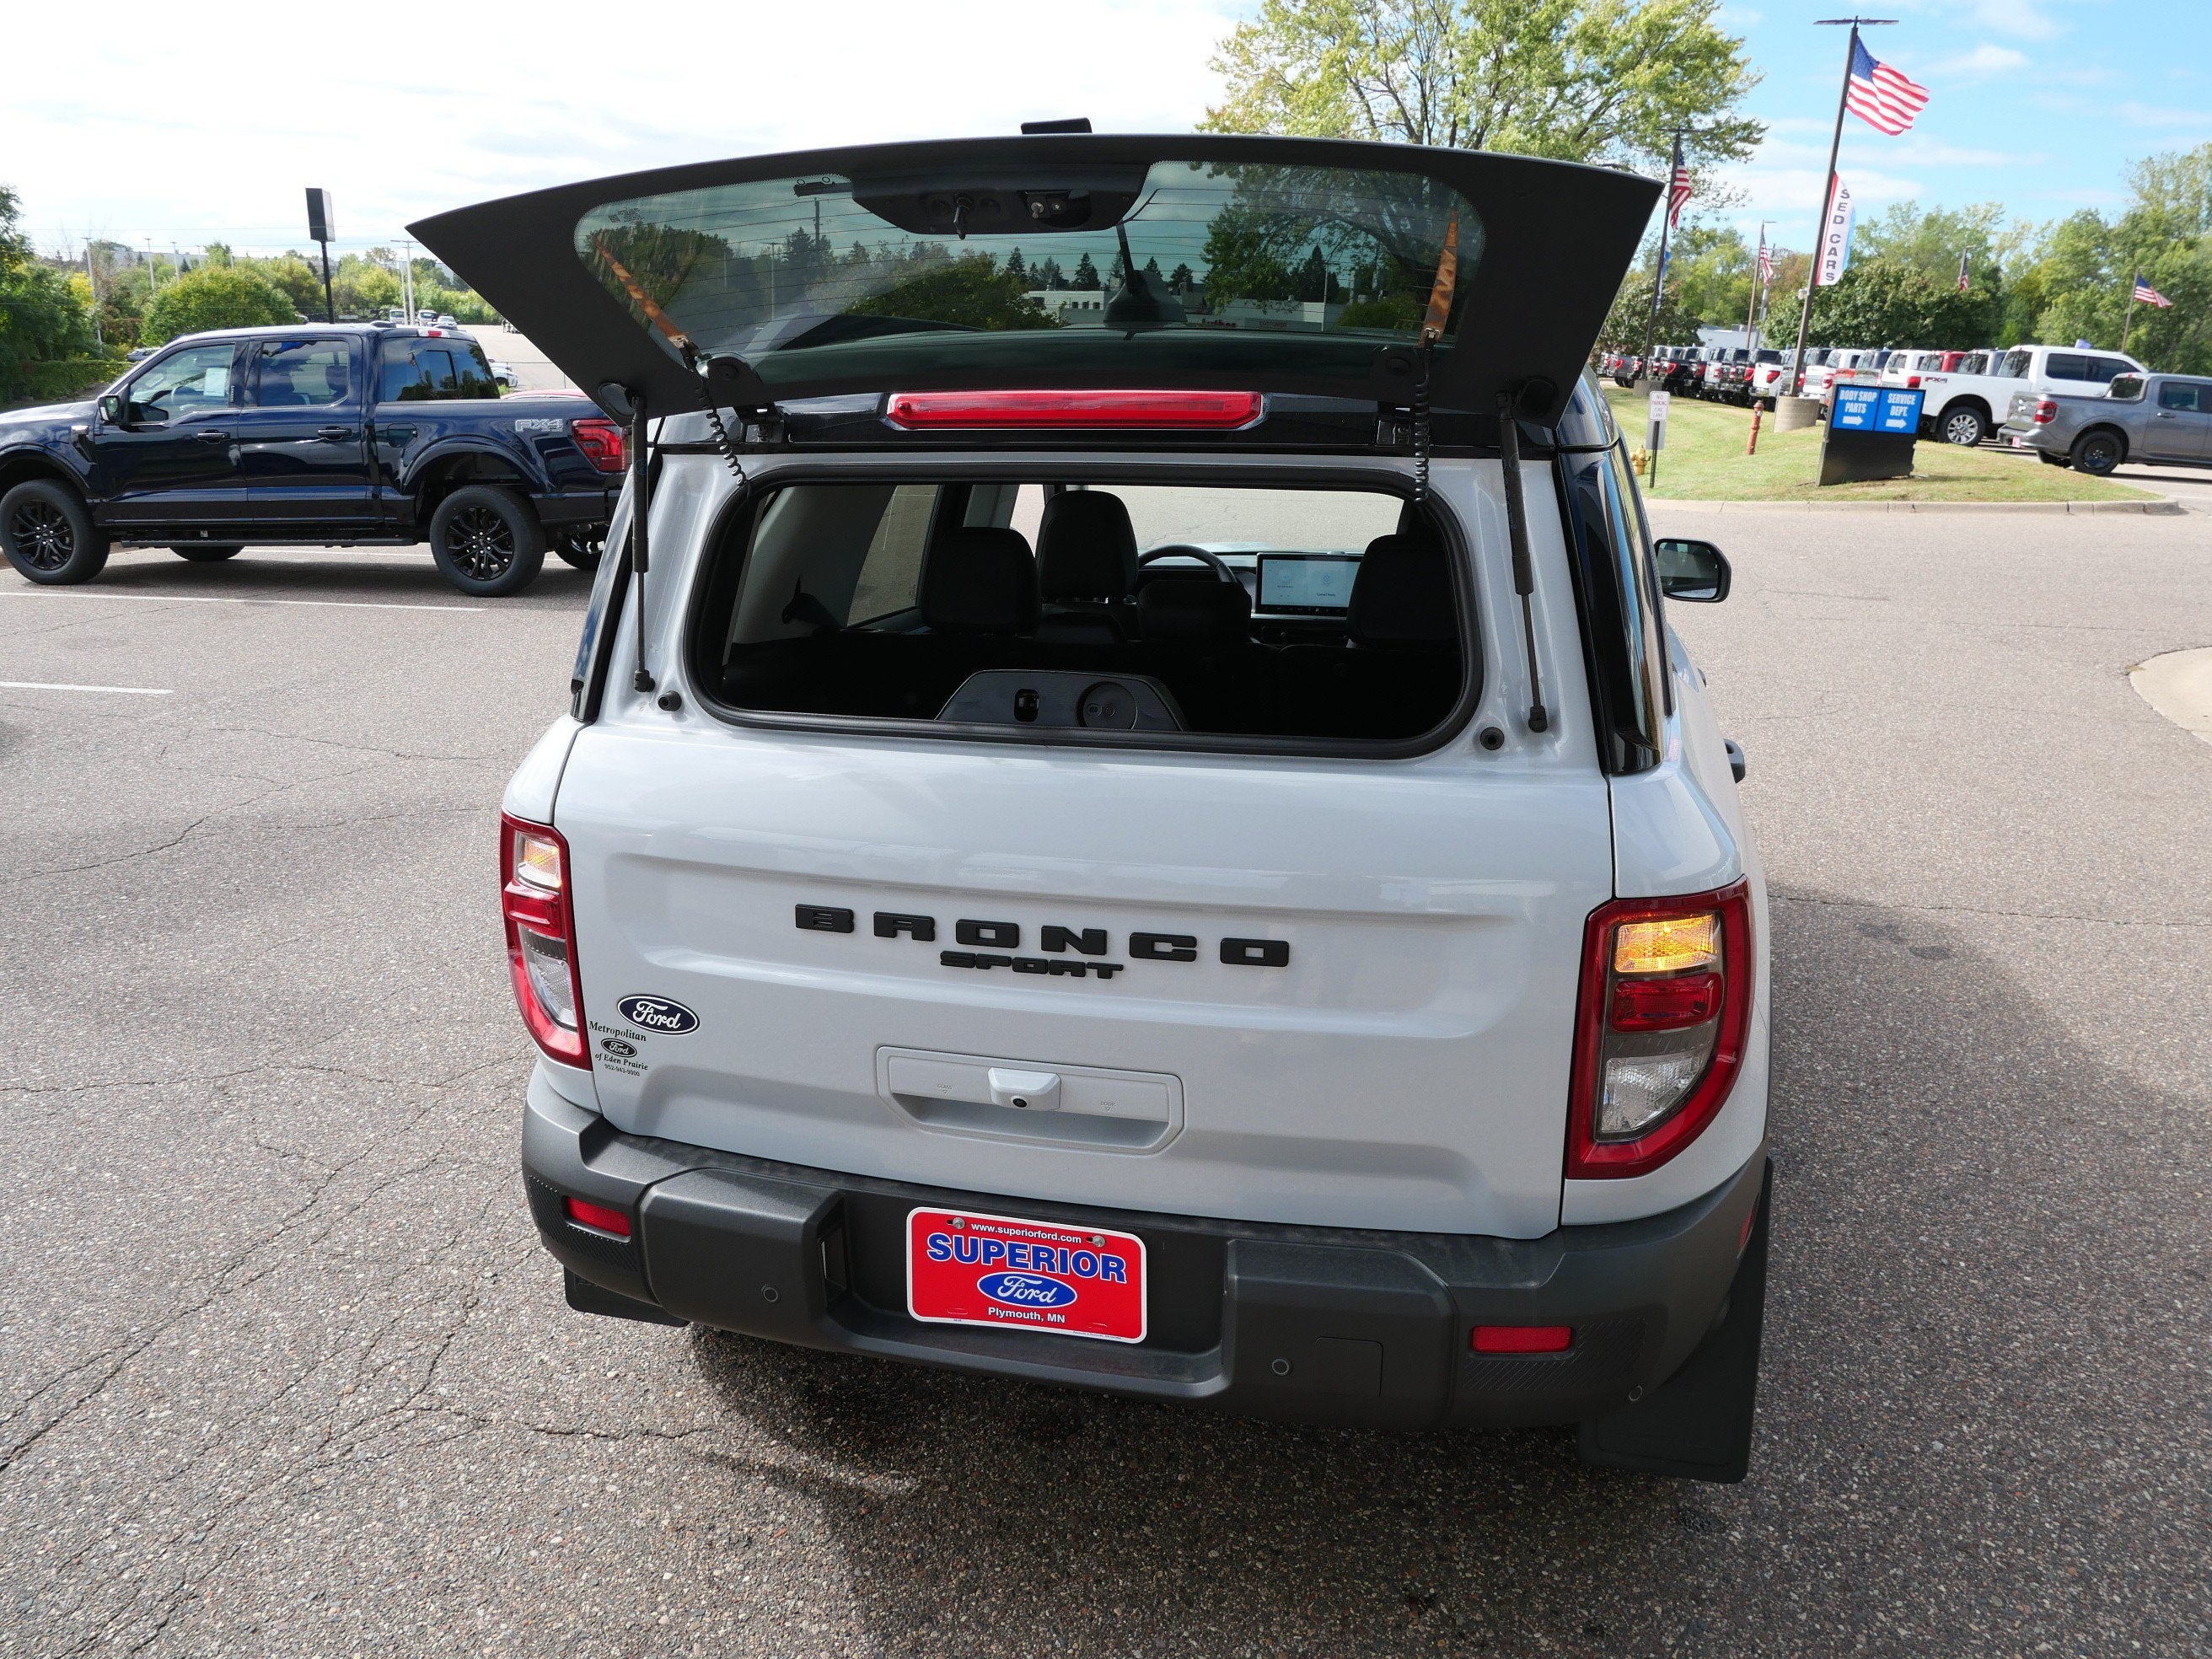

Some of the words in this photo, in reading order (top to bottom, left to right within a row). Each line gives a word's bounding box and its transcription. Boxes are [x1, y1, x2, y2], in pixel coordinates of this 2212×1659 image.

[1833, 189, 1850, 224] SED
[1826, 234, 1841, 282] CARS
[1839, 389, 1858, 400] BODY
[1858, 391, 1877, 402] SHOP
[1887, 393, 1916, 405] SERVICE
[1844, 402, 1867, 414] PARTS
[1889, 405, 1909, 416] DEPT.
[515, 418, 563, 432] FX4
[795, 904, 1290, 967] BRONCO
[940, 951, 1124, 980] SPORT
[632, 1001, 681, 1028] Ford
[589, 1021, 647, 1042] Metropolitan
[609, 1041, 629, 1055] Ford
[595, 1053, 603, 1061] of
[604, 1055, 621, 1065] Eden
[623, 1058, 648, 1071] Prairie
[971, 1222, 1082, 1243] www.superiorford.com
[927, 1232, 1127, 1284] SUPERIOR
[997, 1275, 1057, 1304] Ford
[988, 1307, 1044, 1323] Plymouth,
[1047, 1313, 1066, 1323] MN
